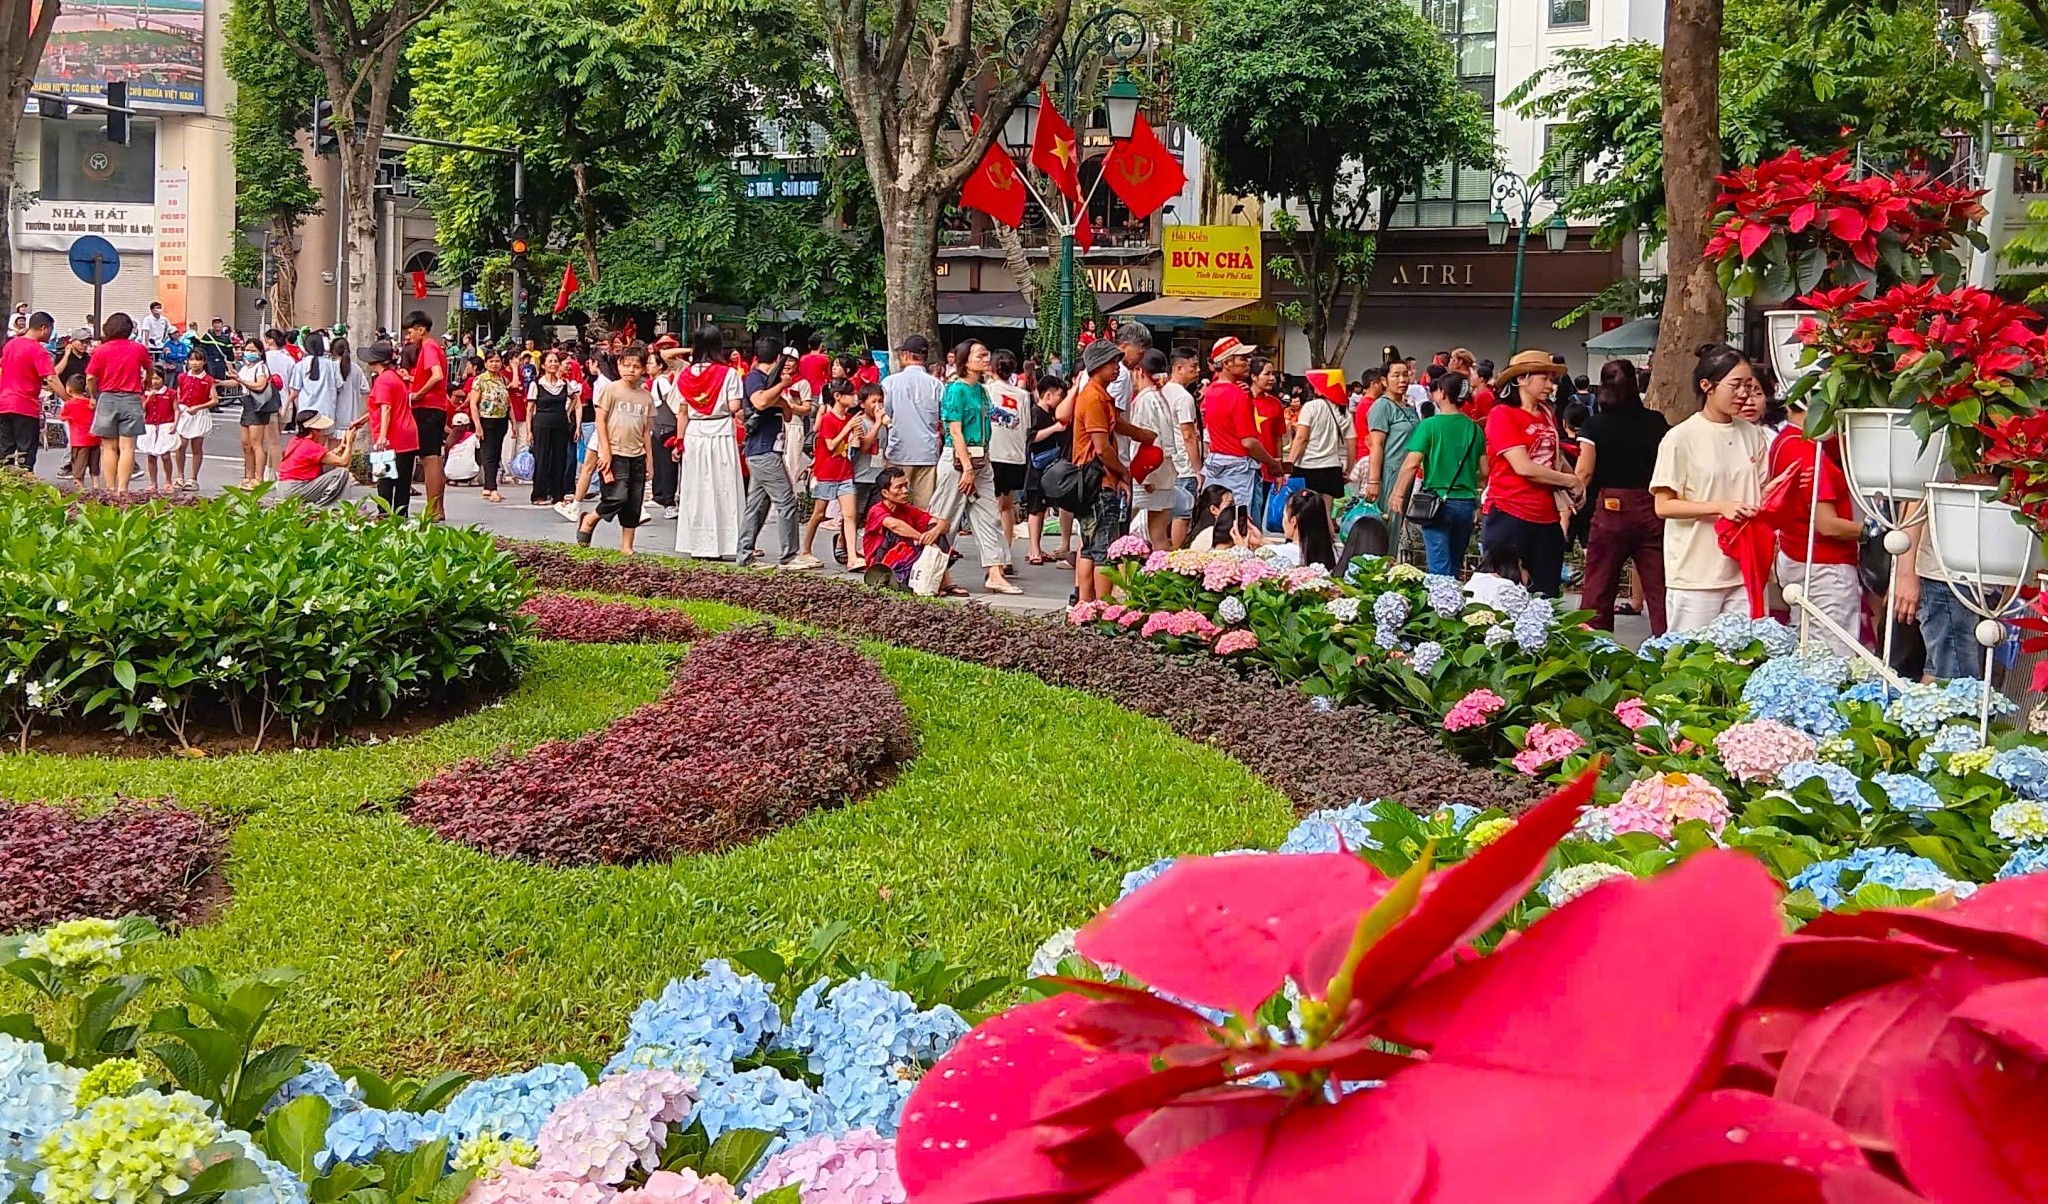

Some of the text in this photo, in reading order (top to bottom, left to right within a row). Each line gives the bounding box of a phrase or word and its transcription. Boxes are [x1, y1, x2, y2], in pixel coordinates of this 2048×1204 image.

[52, 206, 128, 220] NHÀ HÁT
[53, 222, 66, 231] CAO
[108, 223, 128, 235] THUẬT
[130, 223, 140, 234] HÀ
[141, 224, 154, 236] NỘI
[1171, 245, 1254, 269] BÚN CHẢ
[1392, 264, 1474, 285] ATRI
